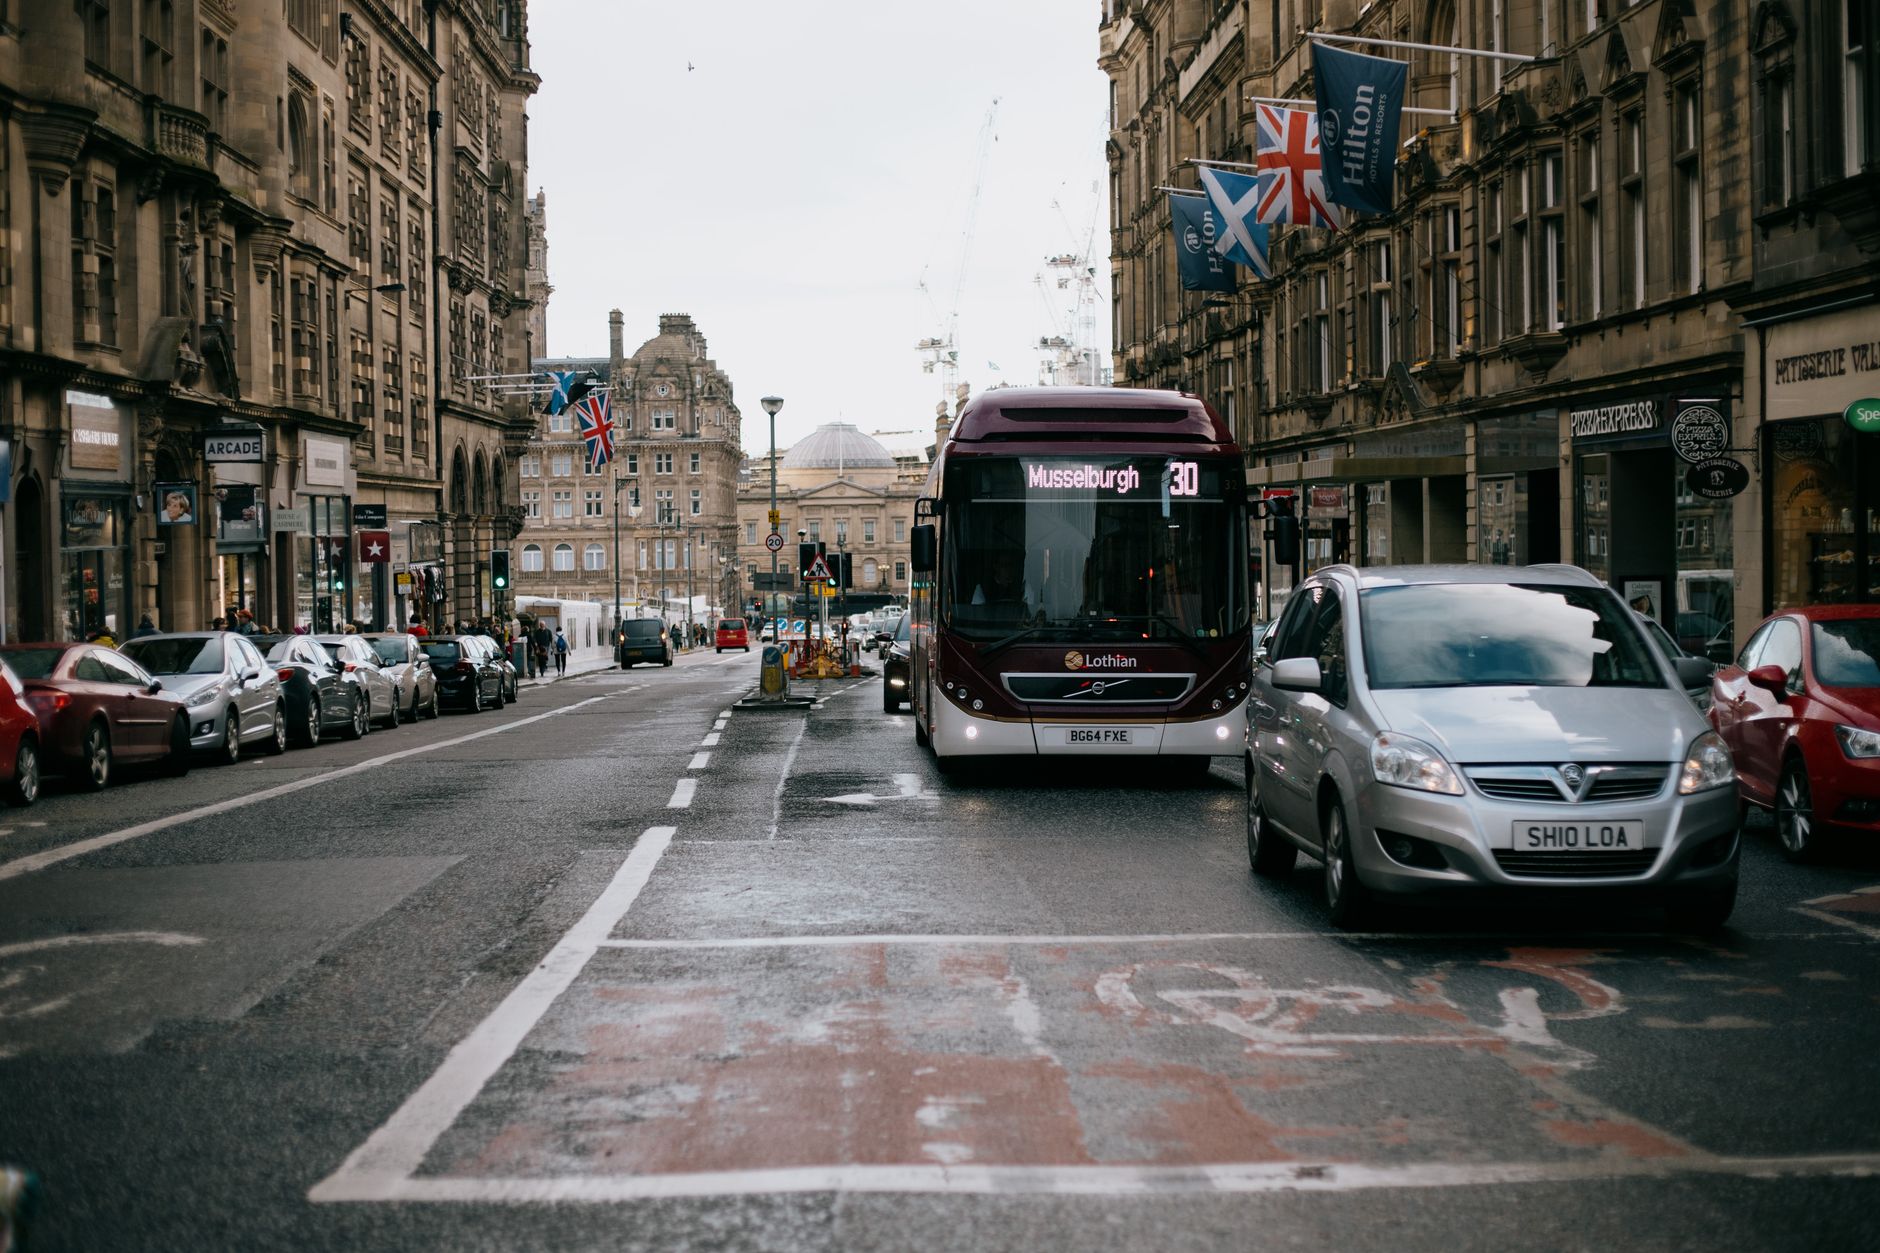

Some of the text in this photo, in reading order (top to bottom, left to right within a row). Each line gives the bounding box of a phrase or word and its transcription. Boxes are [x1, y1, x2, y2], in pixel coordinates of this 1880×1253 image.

[1374, 93, 1387, 136] RESORTS
[1342, 84, 1375, 187] Hilton
[1369, 147, 1380, 184] HOTELS
[1775, 341, 1880, 385] PATISSERIE VAL
[1570, 400, 1655, 437] PIZZAEXPRESS
[1686, 425, 1714, 434] PIZZA
[207, 442, 260, 455] ARCADE
[1695, 459, 1741, 472] PATISSERIE
[1028, 462, 1198, 496] Musselburgh 30
[1702, 487, 1734, 497] VALERIE
[768, 538, 781, 547] 20
[1085, 654, 1137, 668] Lothian
[1070, 730, 1128, 742] BG64 FXE
[1585, 825, 1629, 848] LOA
